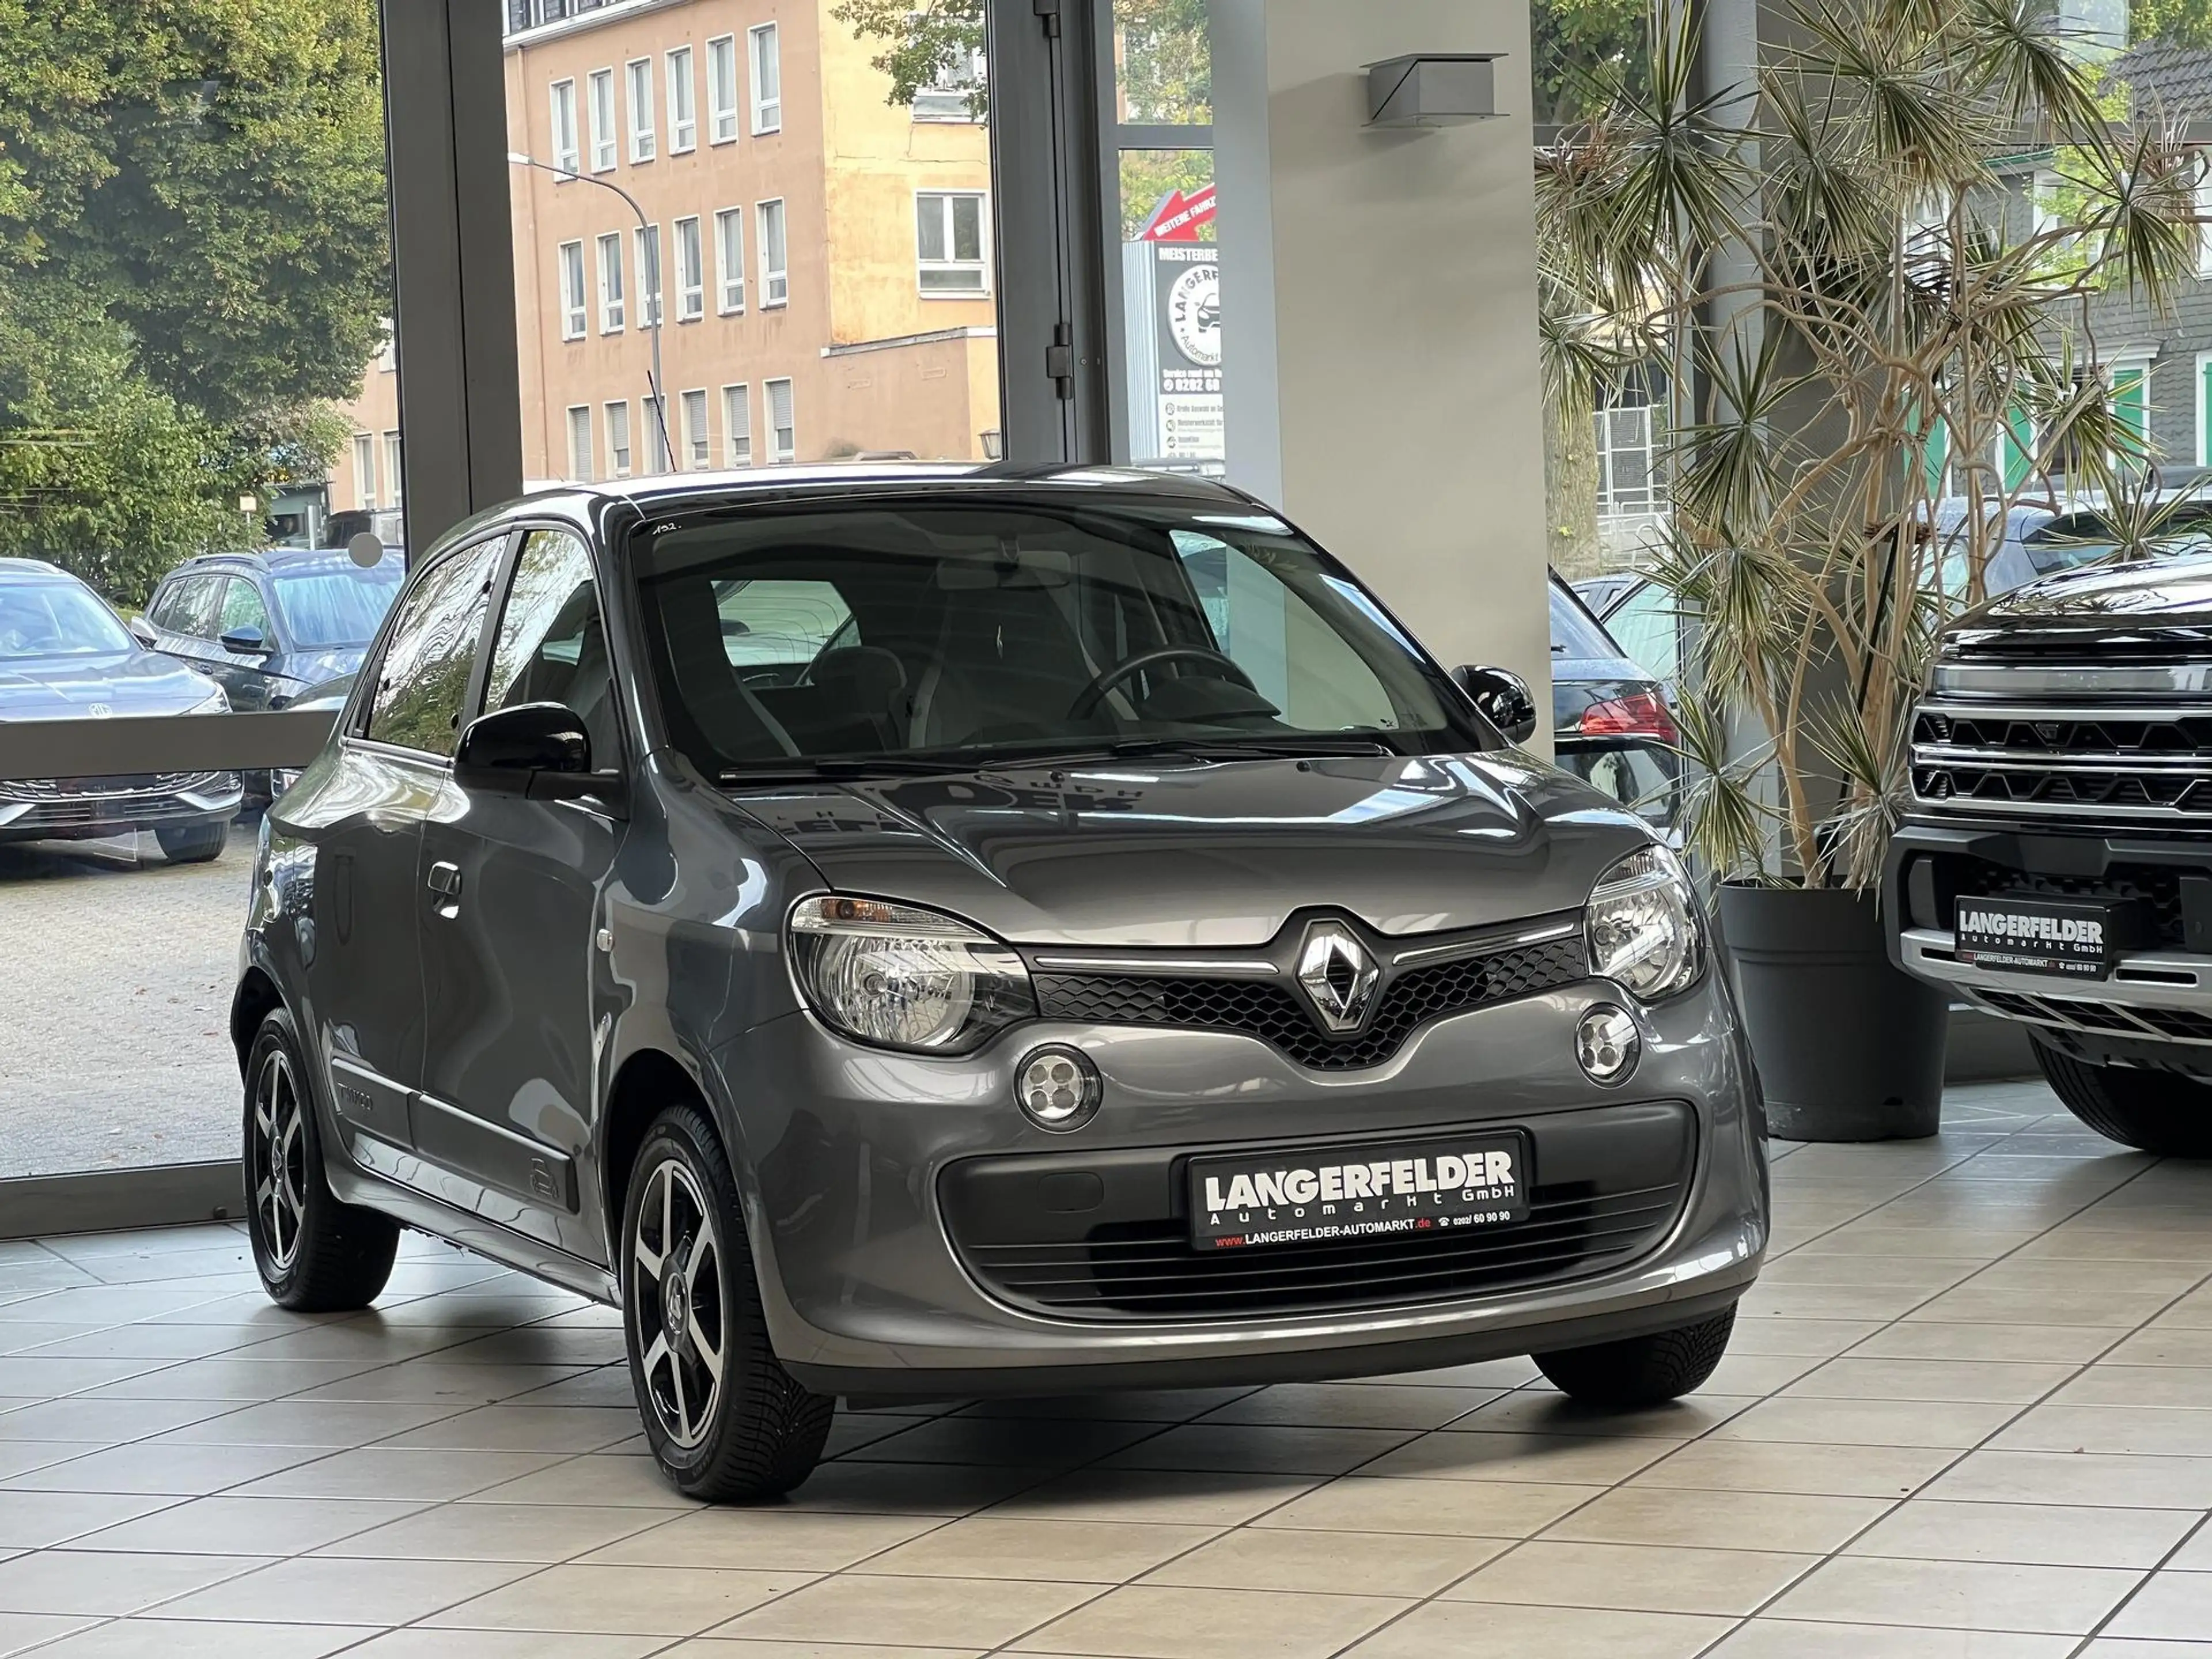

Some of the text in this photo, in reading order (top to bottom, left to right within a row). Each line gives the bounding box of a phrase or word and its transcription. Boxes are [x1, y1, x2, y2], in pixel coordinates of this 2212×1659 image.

[1960, 911, 2104, 944] LANGERFELDER
[2074, 944, 2103, 953] GmbH
[1206, 1151, 1516, 1211] LANGERFELDER
[1461, 1185, 1514, 1201] GmbH
[1215, 1217, 1431, 1247] www.LANGERFELDER-AUTOMARKT.de
[1473, 1213, 1484, 1224] 60
[1486, 1212, 1497, 1222] 90
[1499, 1210, 1510, 1221] 90
